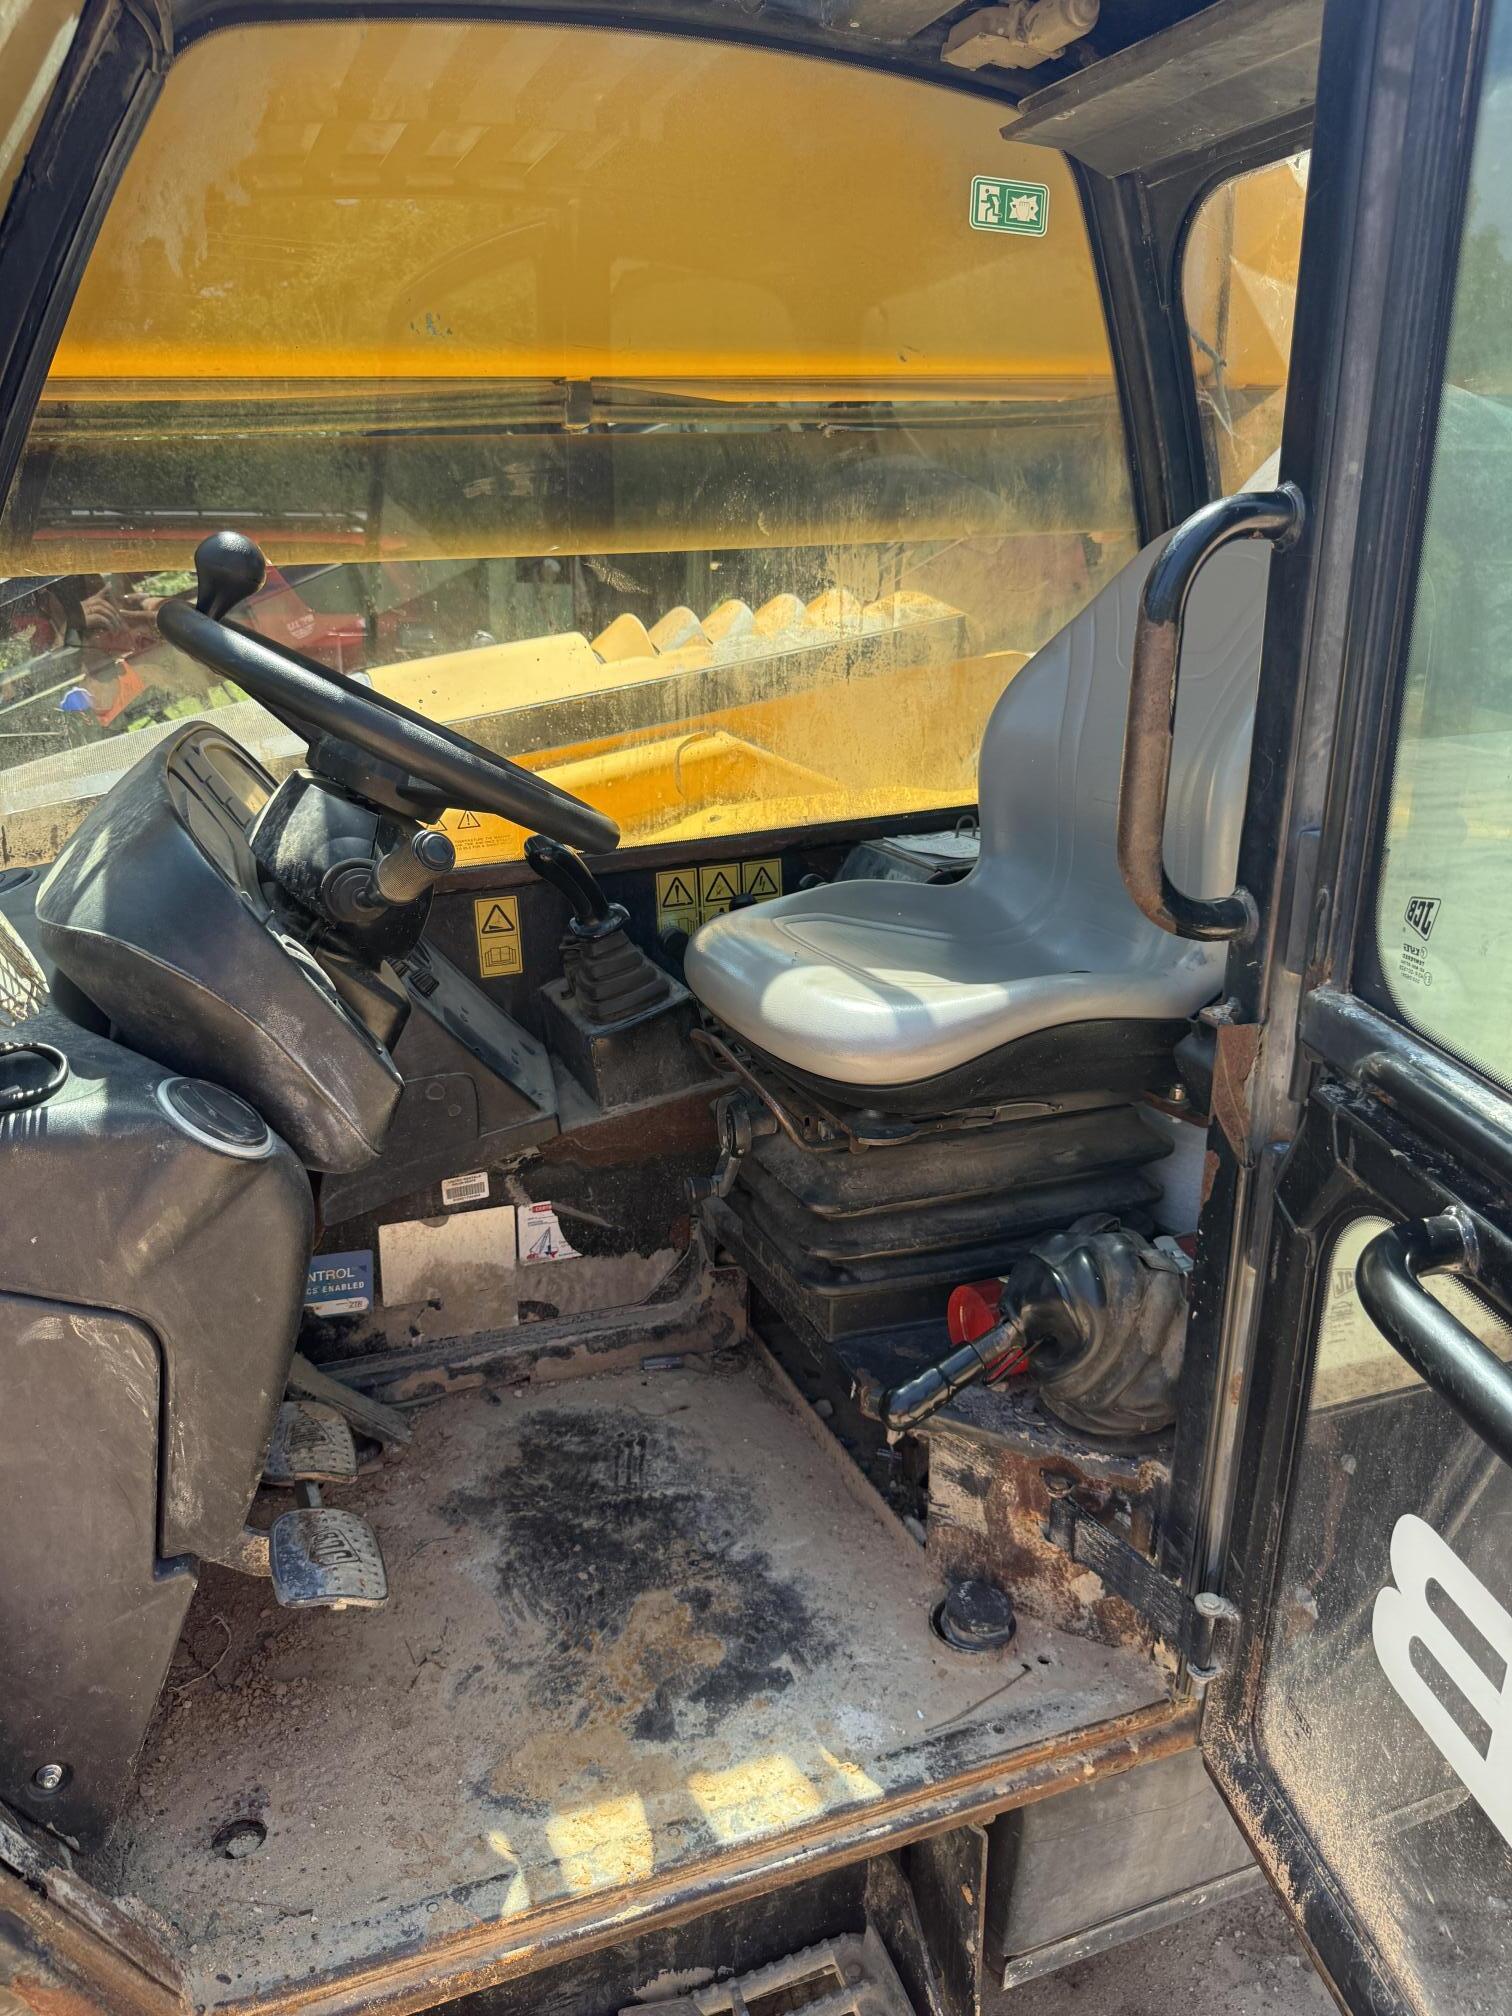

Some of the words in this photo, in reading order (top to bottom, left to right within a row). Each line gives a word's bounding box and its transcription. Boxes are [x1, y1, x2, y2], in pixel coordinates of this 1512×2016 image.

[308, 1267, 355, 1282] NTROL
[1336, 1270, 1353, 1294] JC
[306, 1287, 318, 1295] CS
[322, 1281, 365, 1293] ENABLED
